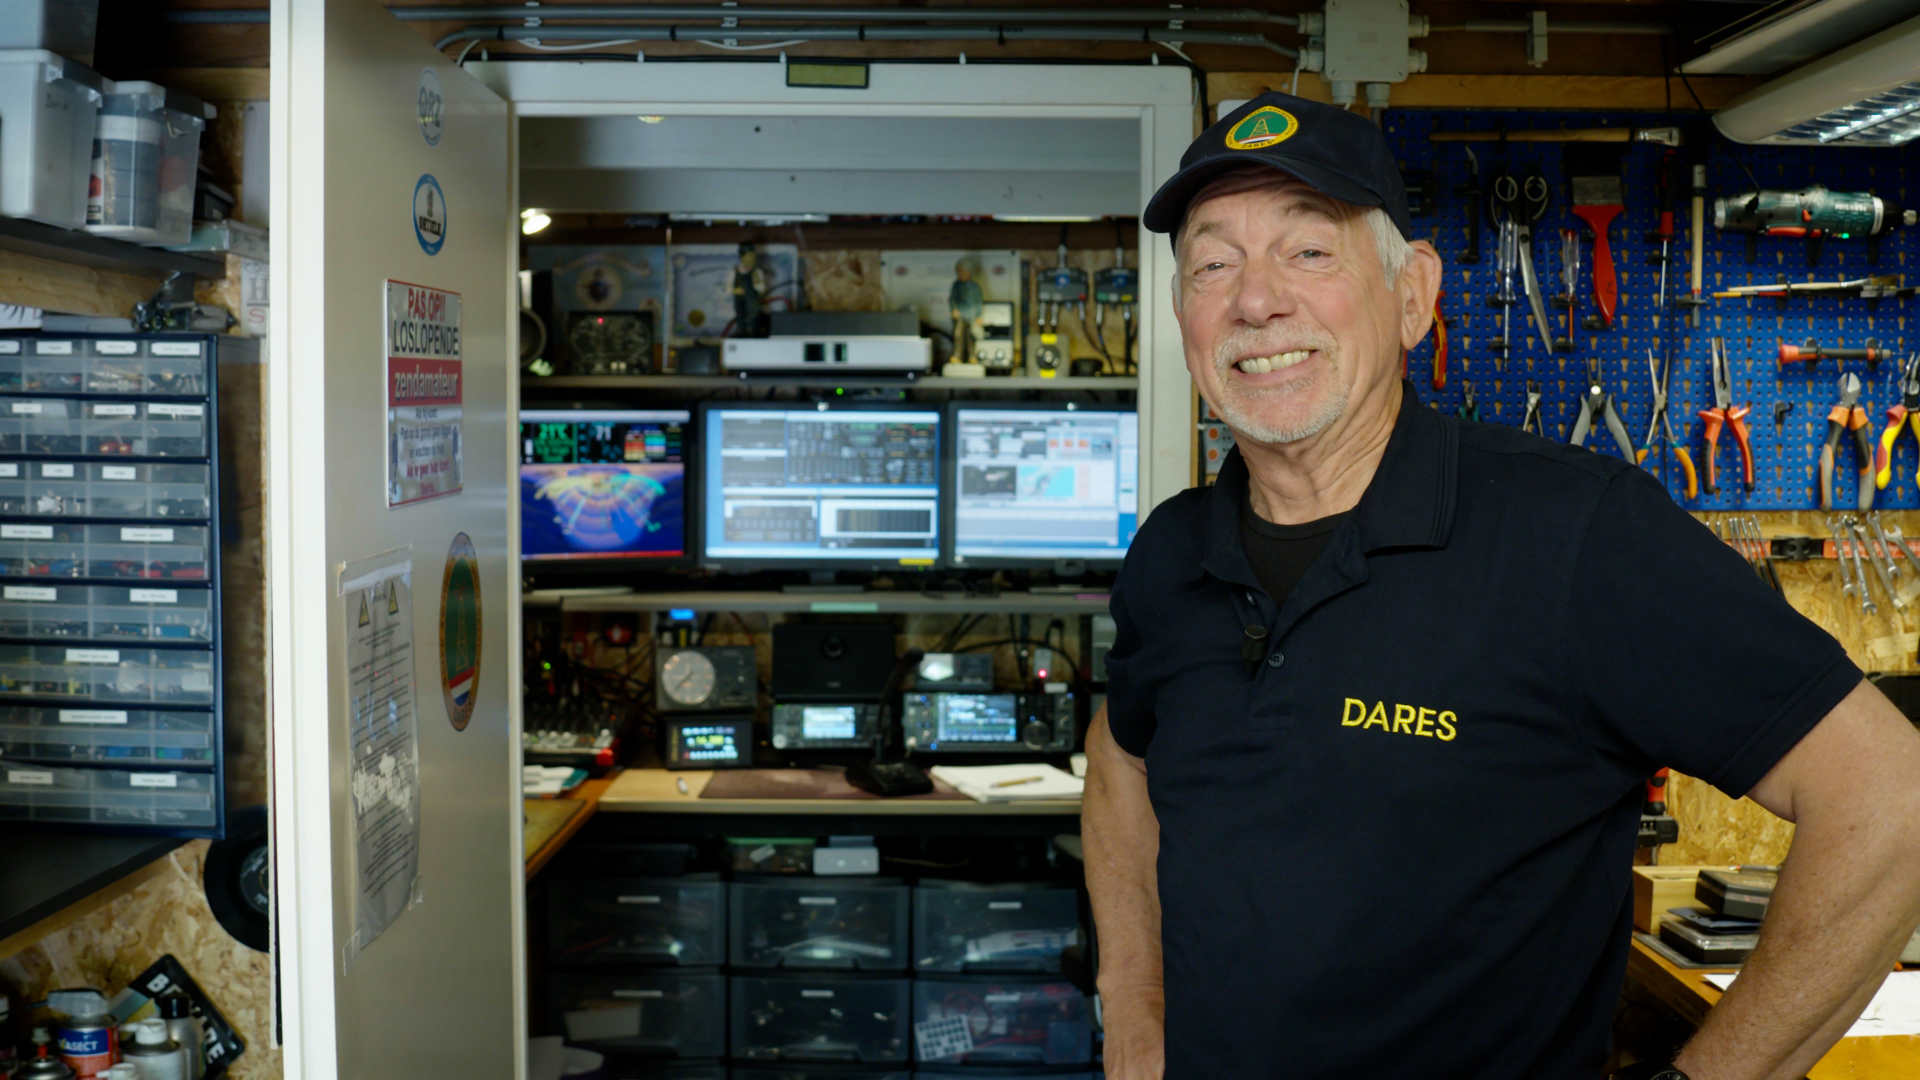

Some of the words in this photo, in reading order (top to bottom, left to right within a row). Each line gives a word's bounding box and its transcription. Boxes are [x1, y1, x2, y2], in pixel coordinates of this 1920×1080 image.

[408, 287, 426, 320] PAS
[394, 320, 459, 355] LOSLOPENDE
[395, 363, 458, 398] zendamateur
[1341, 697, 1458, 741] DARES
